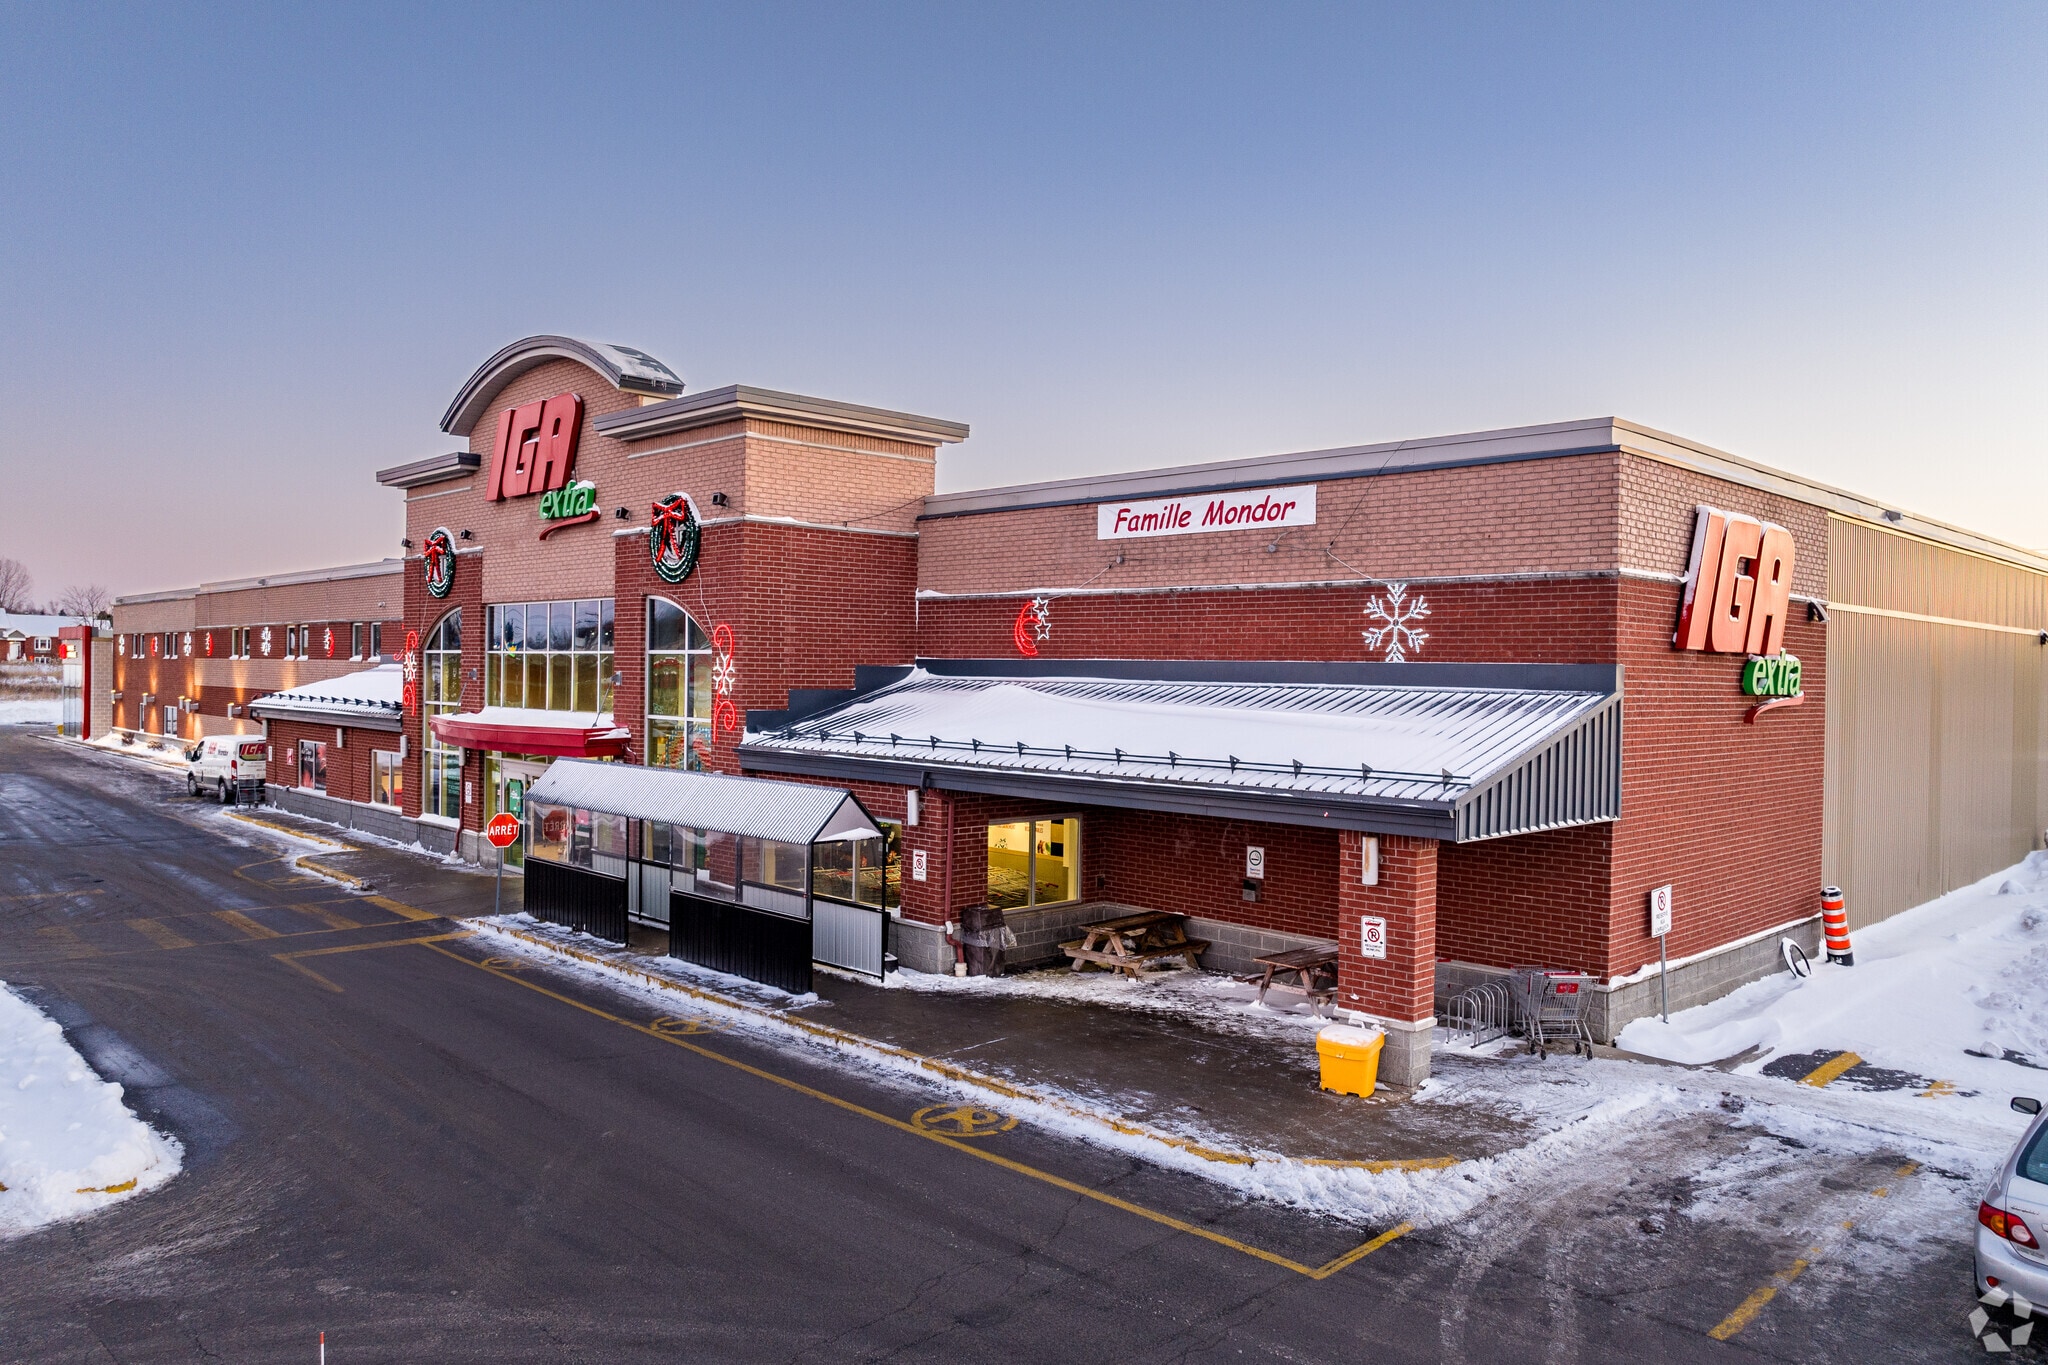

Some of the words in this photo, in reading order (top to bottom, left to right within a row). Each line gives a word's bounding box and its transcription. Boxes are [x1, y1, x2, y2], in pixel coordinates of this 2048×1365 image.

[486, 392, 581, 501] IGA
[539, 480, 589, 520] extra
[1113, 502, 1192, 534] Famille
[1201, 494, 1297, 527] Mondor
[1681, 509, 1796, 656] IGA
[1751, 649, 1802, 697] extra
[241, 743, 266, 755] IGA
[489, 823, 518, 836] ARRÊT
